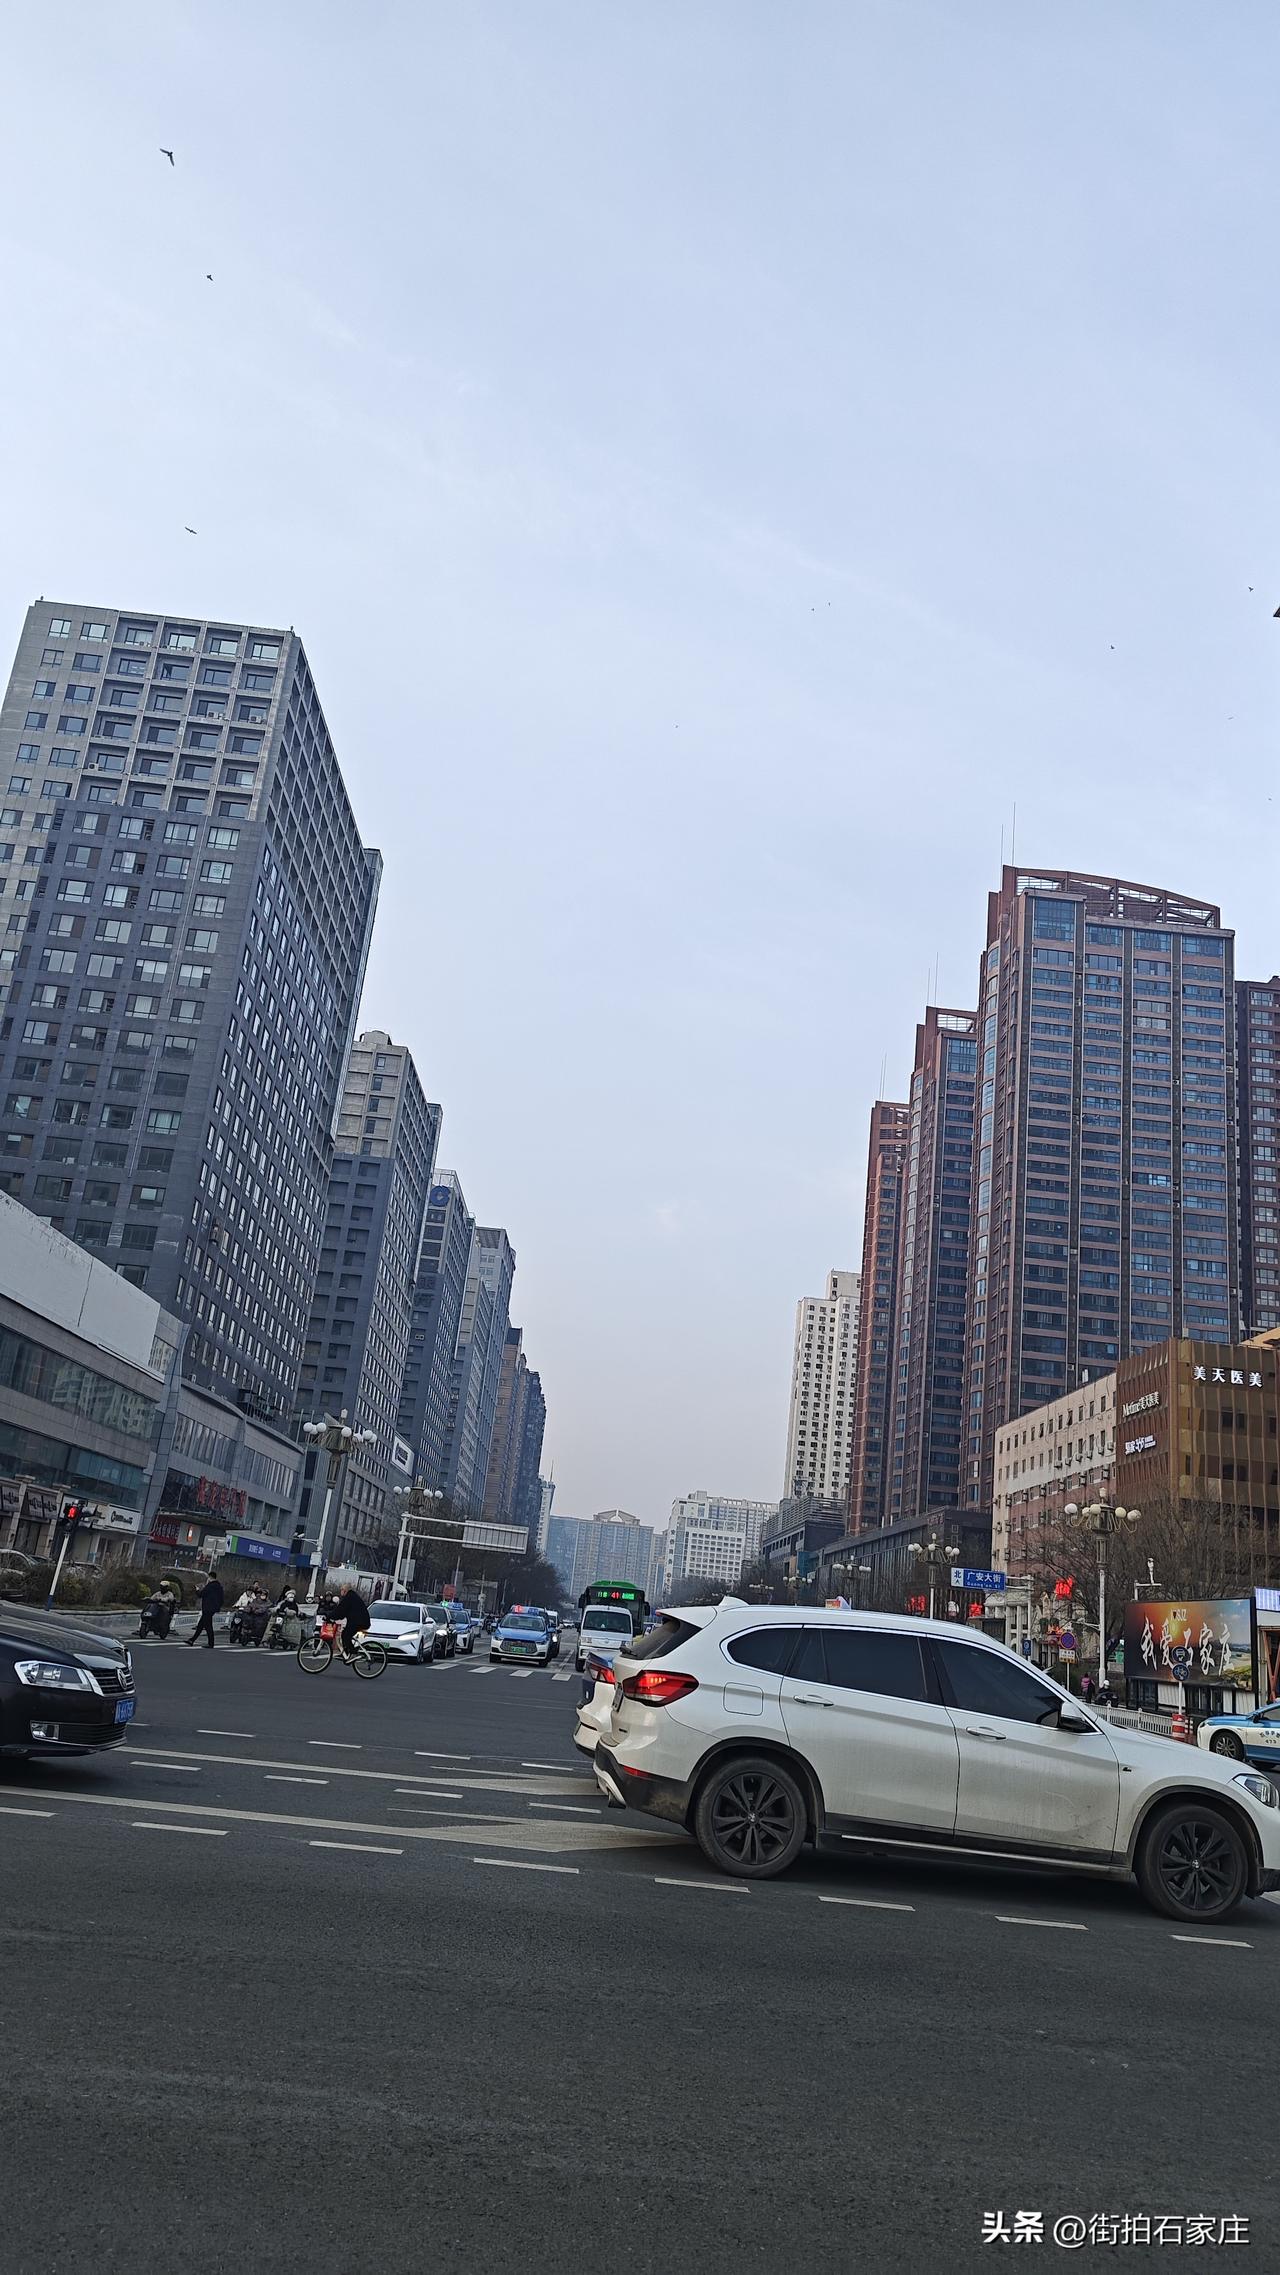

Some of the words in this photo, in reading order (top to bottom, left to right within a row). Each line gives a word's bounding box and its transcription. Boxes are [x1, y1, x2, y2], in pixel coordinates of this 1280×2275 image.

[1193, 1365, 1263, 1388] 美天医美
[954, 1570, 961, 1578] 北
[967, 1571, 1001, 1583] 广安大街
[611, 1591, 620, 1599] 41
